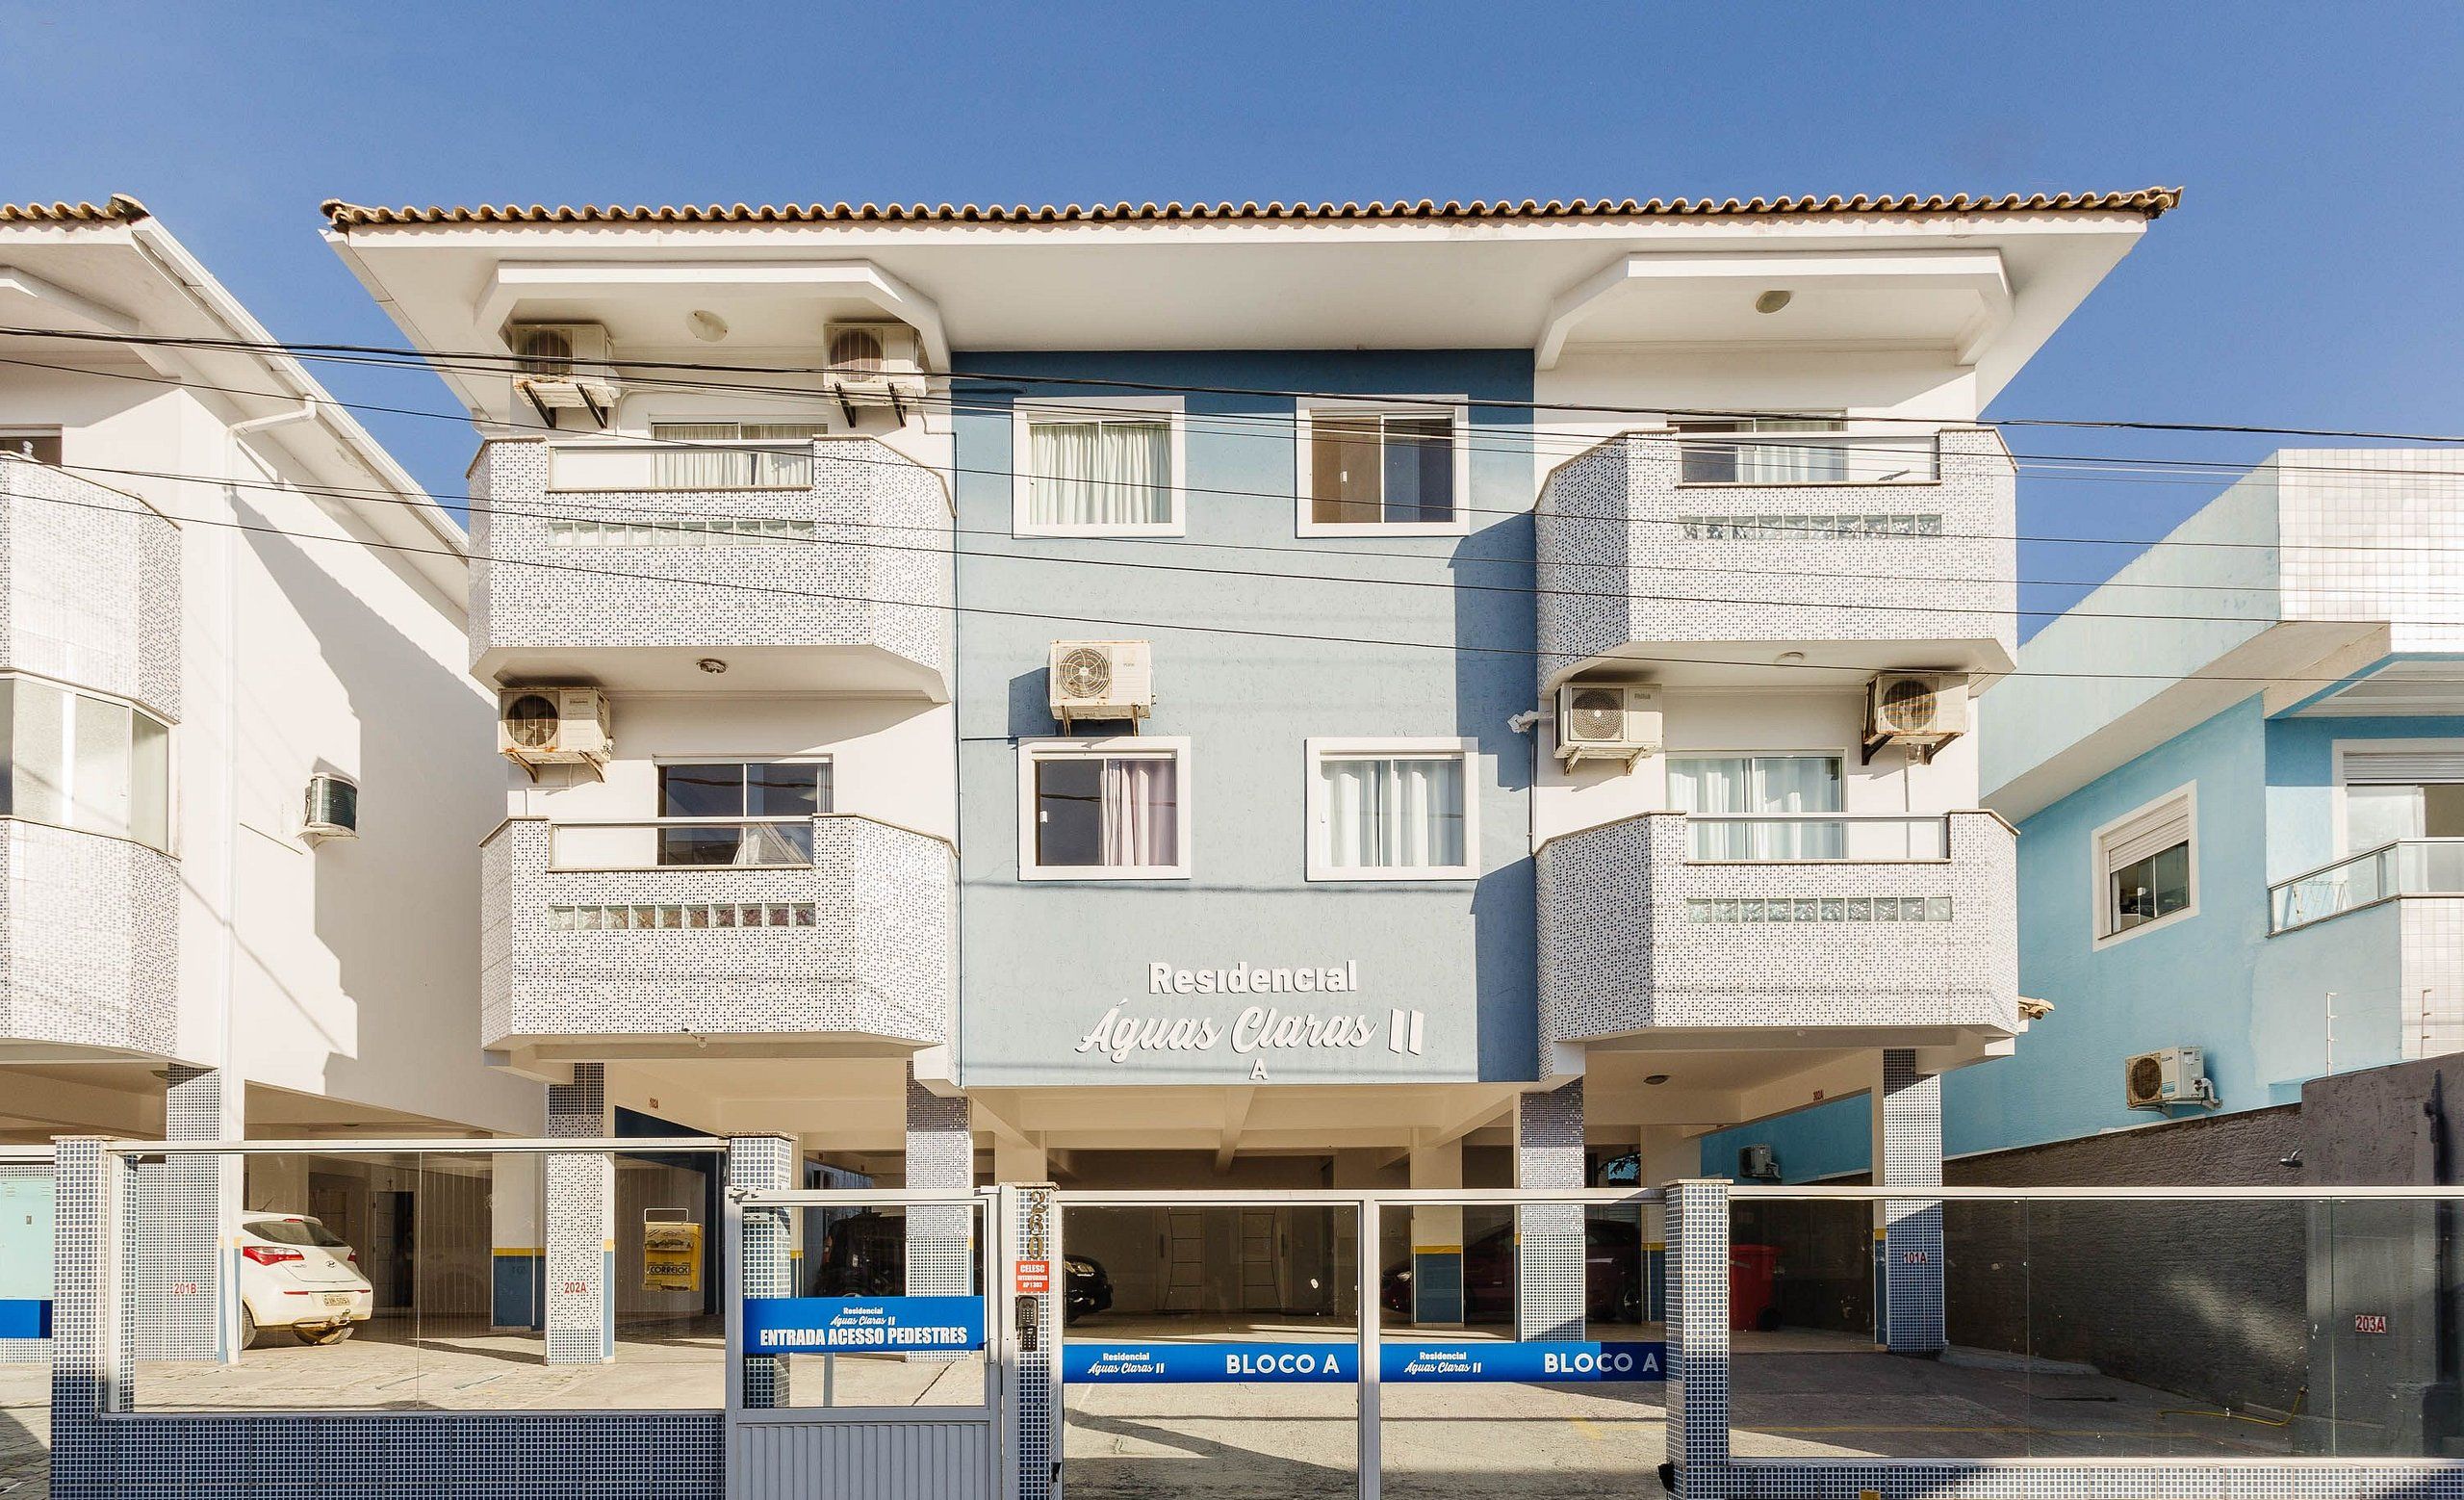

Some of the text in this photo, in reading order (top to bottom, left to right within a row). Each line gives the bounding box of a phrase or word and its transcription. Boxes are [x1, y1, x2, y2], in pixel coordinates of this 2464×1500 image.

[1148, 960, 1357, 995] Residencial
[1075, 997, 1424, 1063] Águas Claras II
[1249, 1059, 1268, 1080] A
[1904, 1252, 1927, 1263] 101A
[650, 1266, 688, 1275] CORREIOS
[1020, 1264, 1045, 1273] CELESC
[174, 1283, 196, 1294] 201B
[565, 1281, 587, 1294] 202A
[843, 1306, 883, 1315] Residencial
[859, 1315, 886, 1326] Claras
[2356, 1316, 2385, 1332] 203A
[760, 1327, 966, 1346] ENTRADA ACESSO PEDESTRES
[1103, 1352, 1150, 1361] Residencial
[1420, 1351, 1467, 1360] Residencial
[1120, 1362, 1154, 1374] Claras
[1226, 1354, 1340, 1374] BLOCO A
[1437, 1361, 1471, 1373] Claras
[1544, 1353, 1659, 1373] BLOCO A
